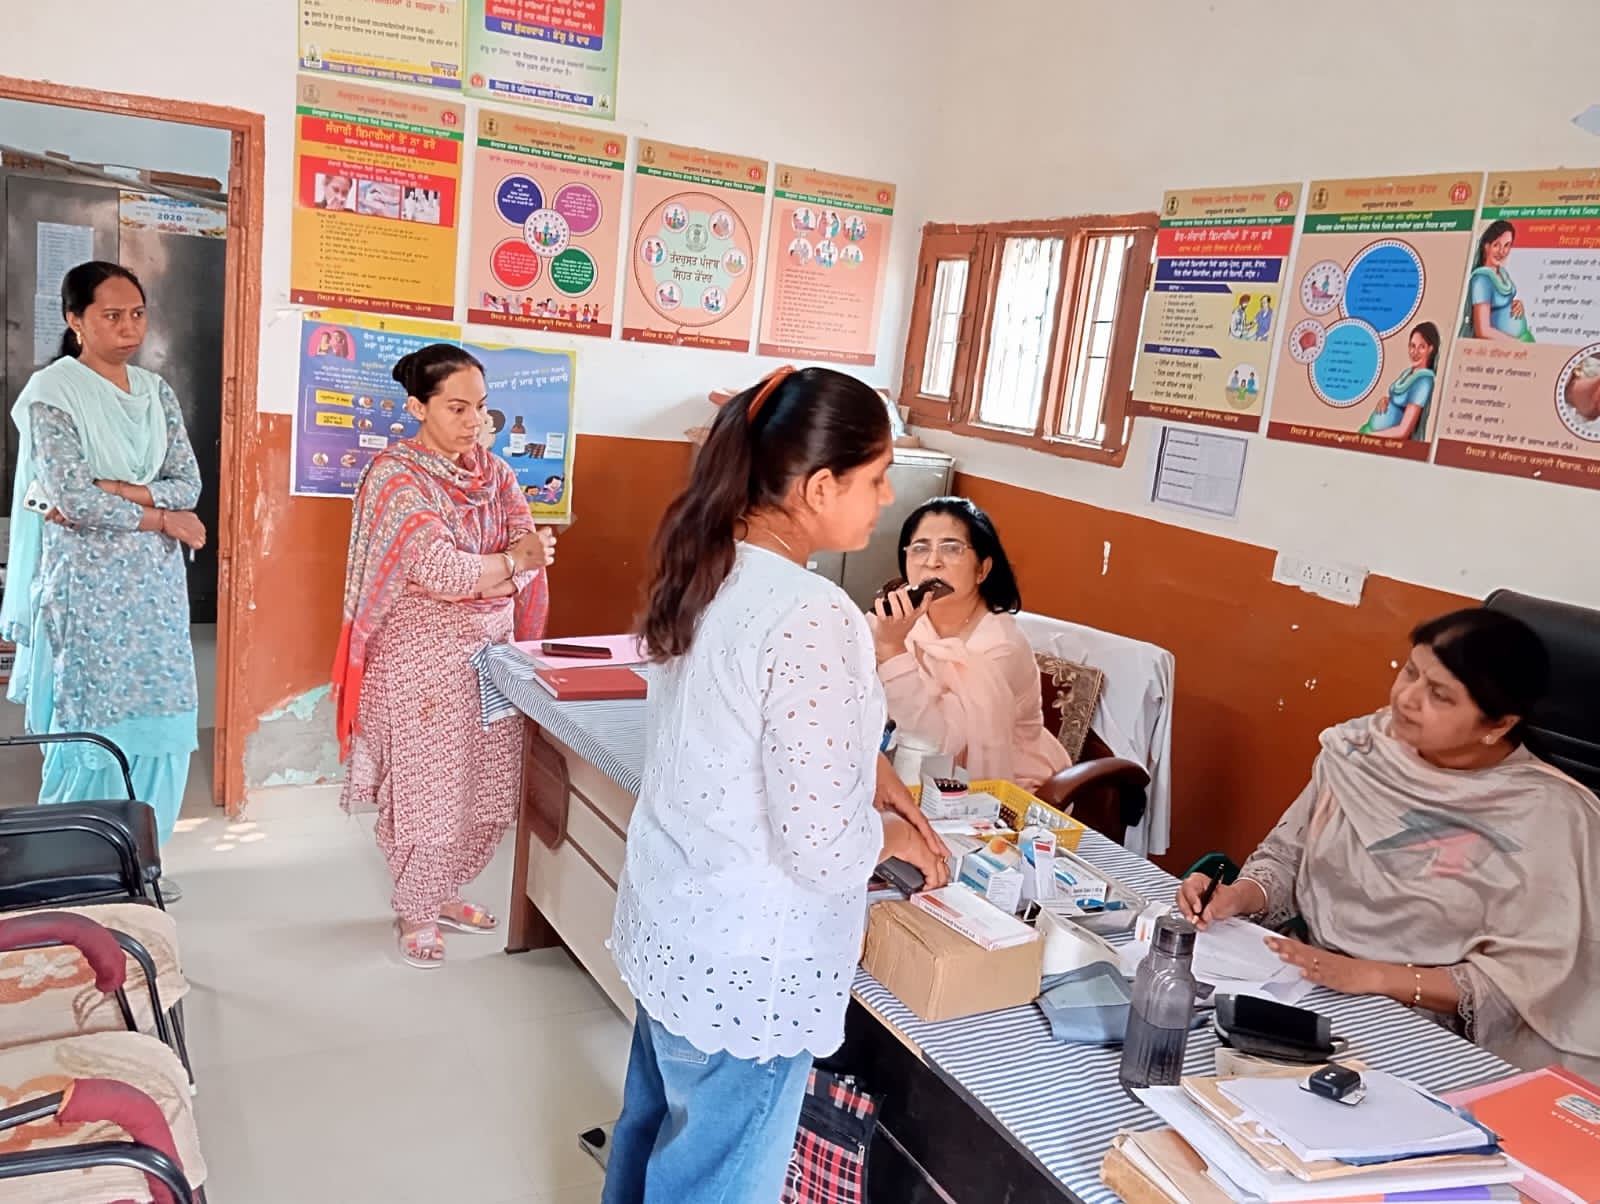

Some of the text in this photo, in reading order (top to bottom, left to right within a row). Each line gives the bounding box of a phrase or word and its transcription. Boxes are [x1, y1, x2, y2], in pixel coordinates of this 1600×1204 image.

[157, 213, 182, 222] 2020
[669, 252, 720, 269] ਤੰਦਰੁਸਤ ਪੰਜਾਬ
[672, 267, 712, 283] ਸਿਹਤ ਕੇਂਦਰ
